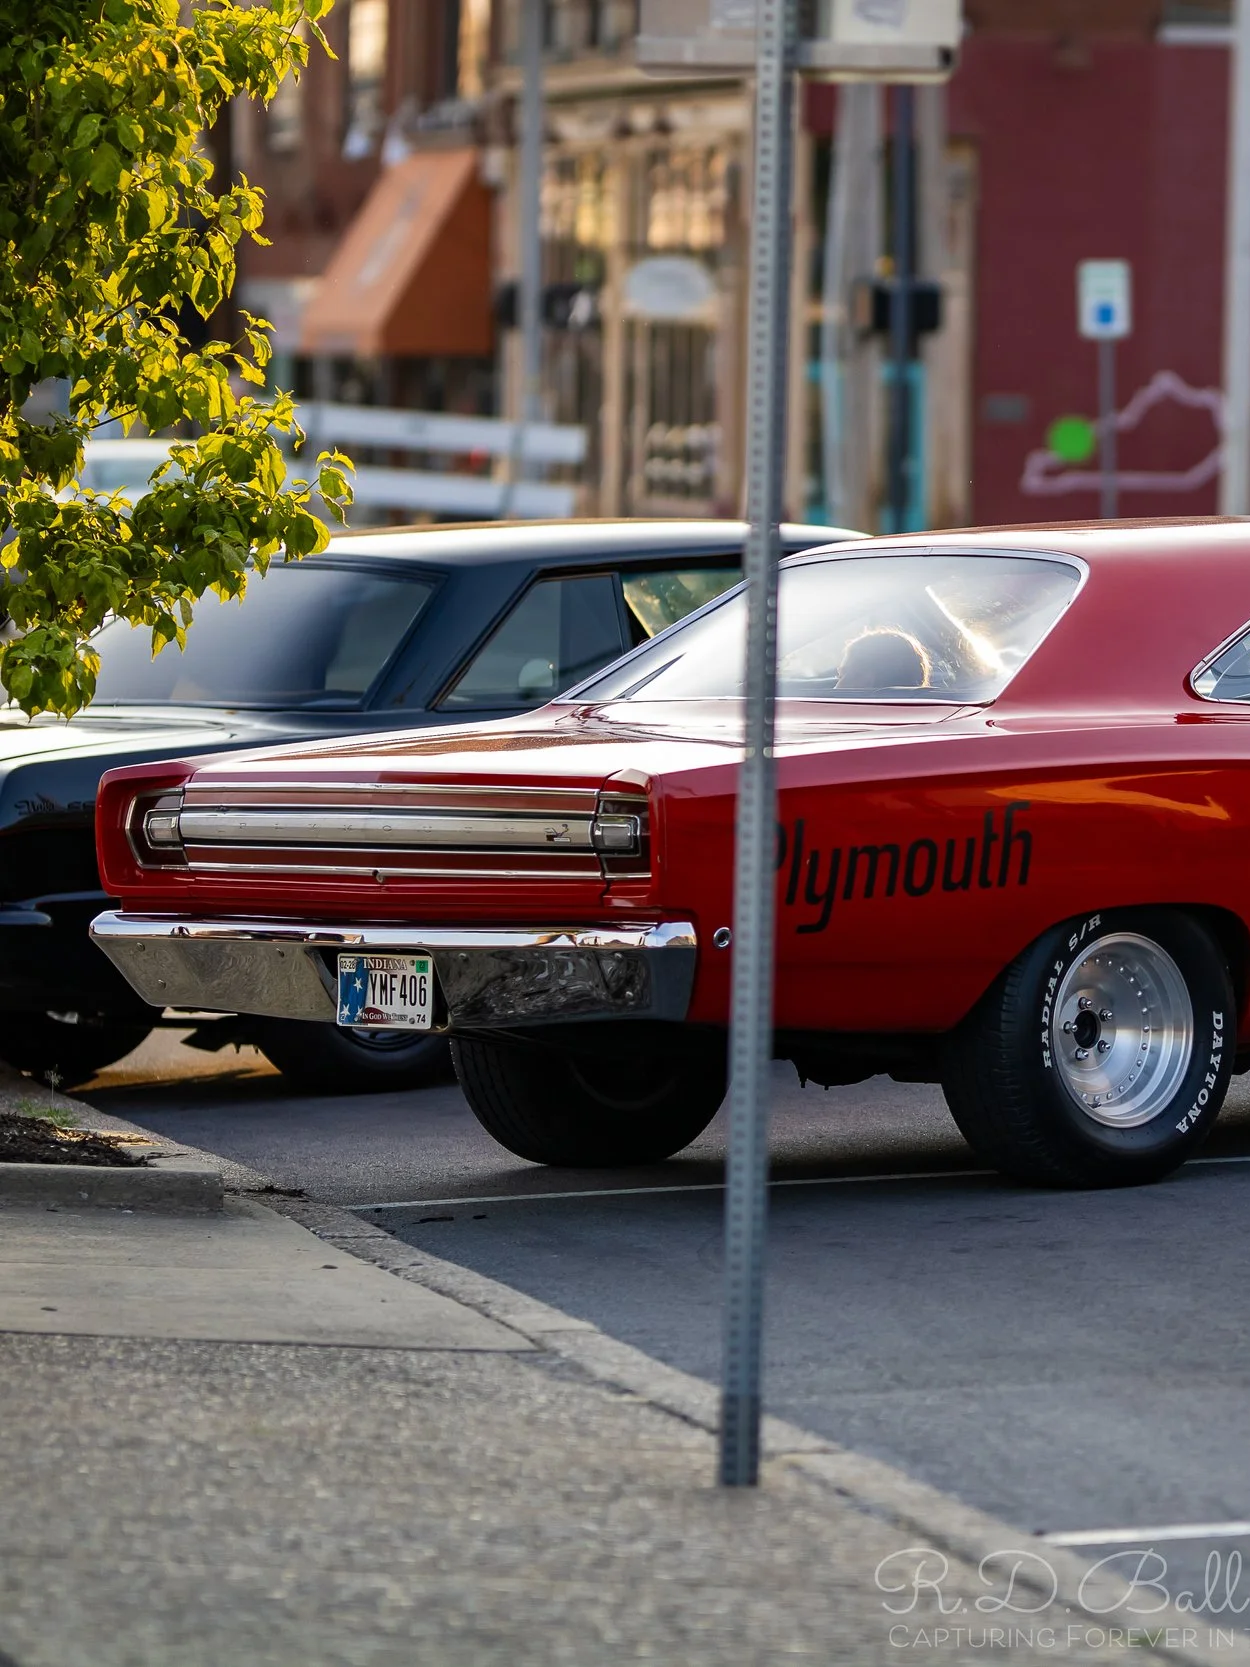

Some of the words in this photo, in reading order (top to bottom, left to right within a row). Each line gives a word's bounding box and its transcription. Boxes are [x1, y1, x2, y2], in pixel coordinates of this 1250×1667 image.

[363, 958, 408, 970] INDIANA
[369, 973, 427, 1007] YMF406
[1041, 960, 1064, 1068] RADIAL
[1068, 913, 1101, 951] S/R
[369, 1012, 382, 1020] GOD
[416, 1014, 426, 1024] 74
[1175, 1010, 1224, 1134] DAYTONA
